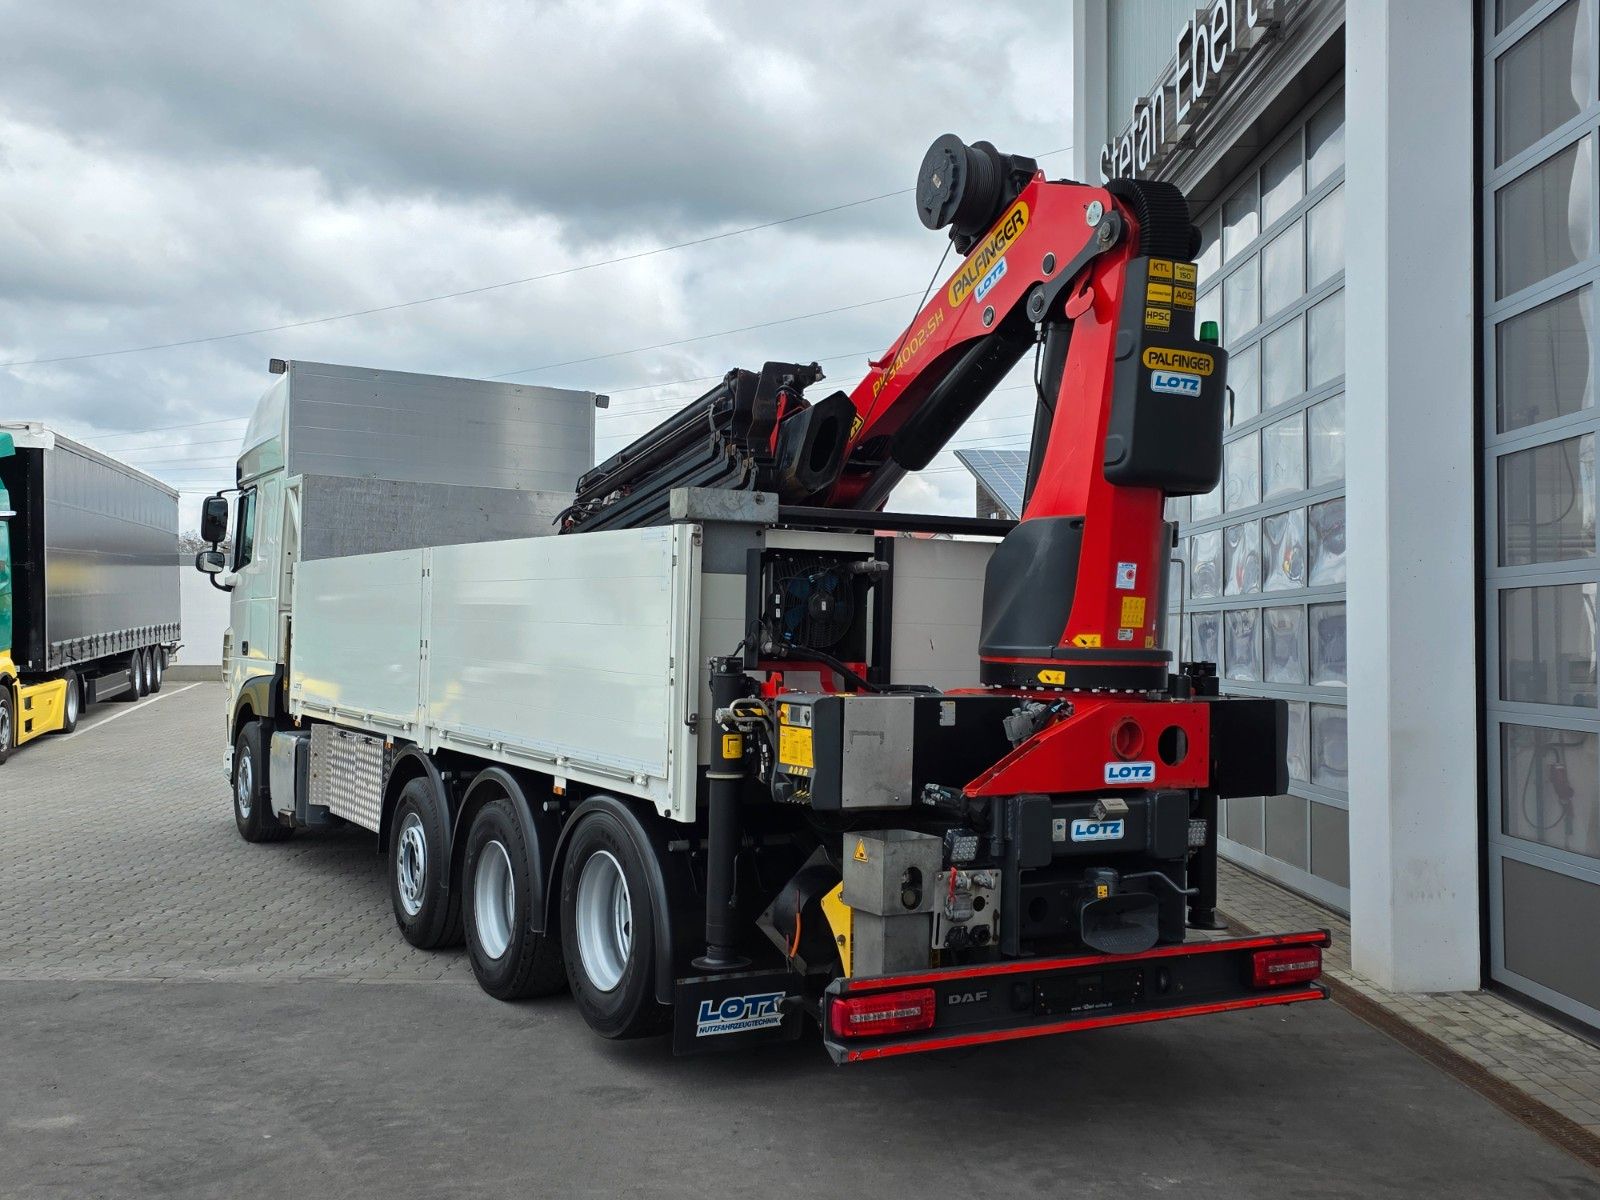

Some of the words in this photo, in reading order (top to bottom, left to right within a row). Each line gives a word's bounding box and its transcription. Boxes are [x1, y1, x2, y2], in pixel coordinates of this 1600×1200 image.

[1101, 86, 1165, 184] Stefan
[952, 208, 1025, 303] PALFINGER
[1153, 262, 1170, 272] KTL
[977, 260, 1005, 298] LOTZ
[1179, 272, 1192, 280] 150
[1176, 291, 1194, 301] AOS
[1146, 310, 1170, 322] HPSC
[1148, 351, 1211, 372] PALFINGER
[1155, 375, 1199, 390] LOTZ
[1108, 766, 1152, 779] LOTZ
[1075, 822, 1121, 836] LOTZ
[948, 991, 988, 1005] DAF
[698, 992, 785, 1025] LOTZ
[699, 1016, 780, 1034] NUTZFAHRZEUGTECHNIK
